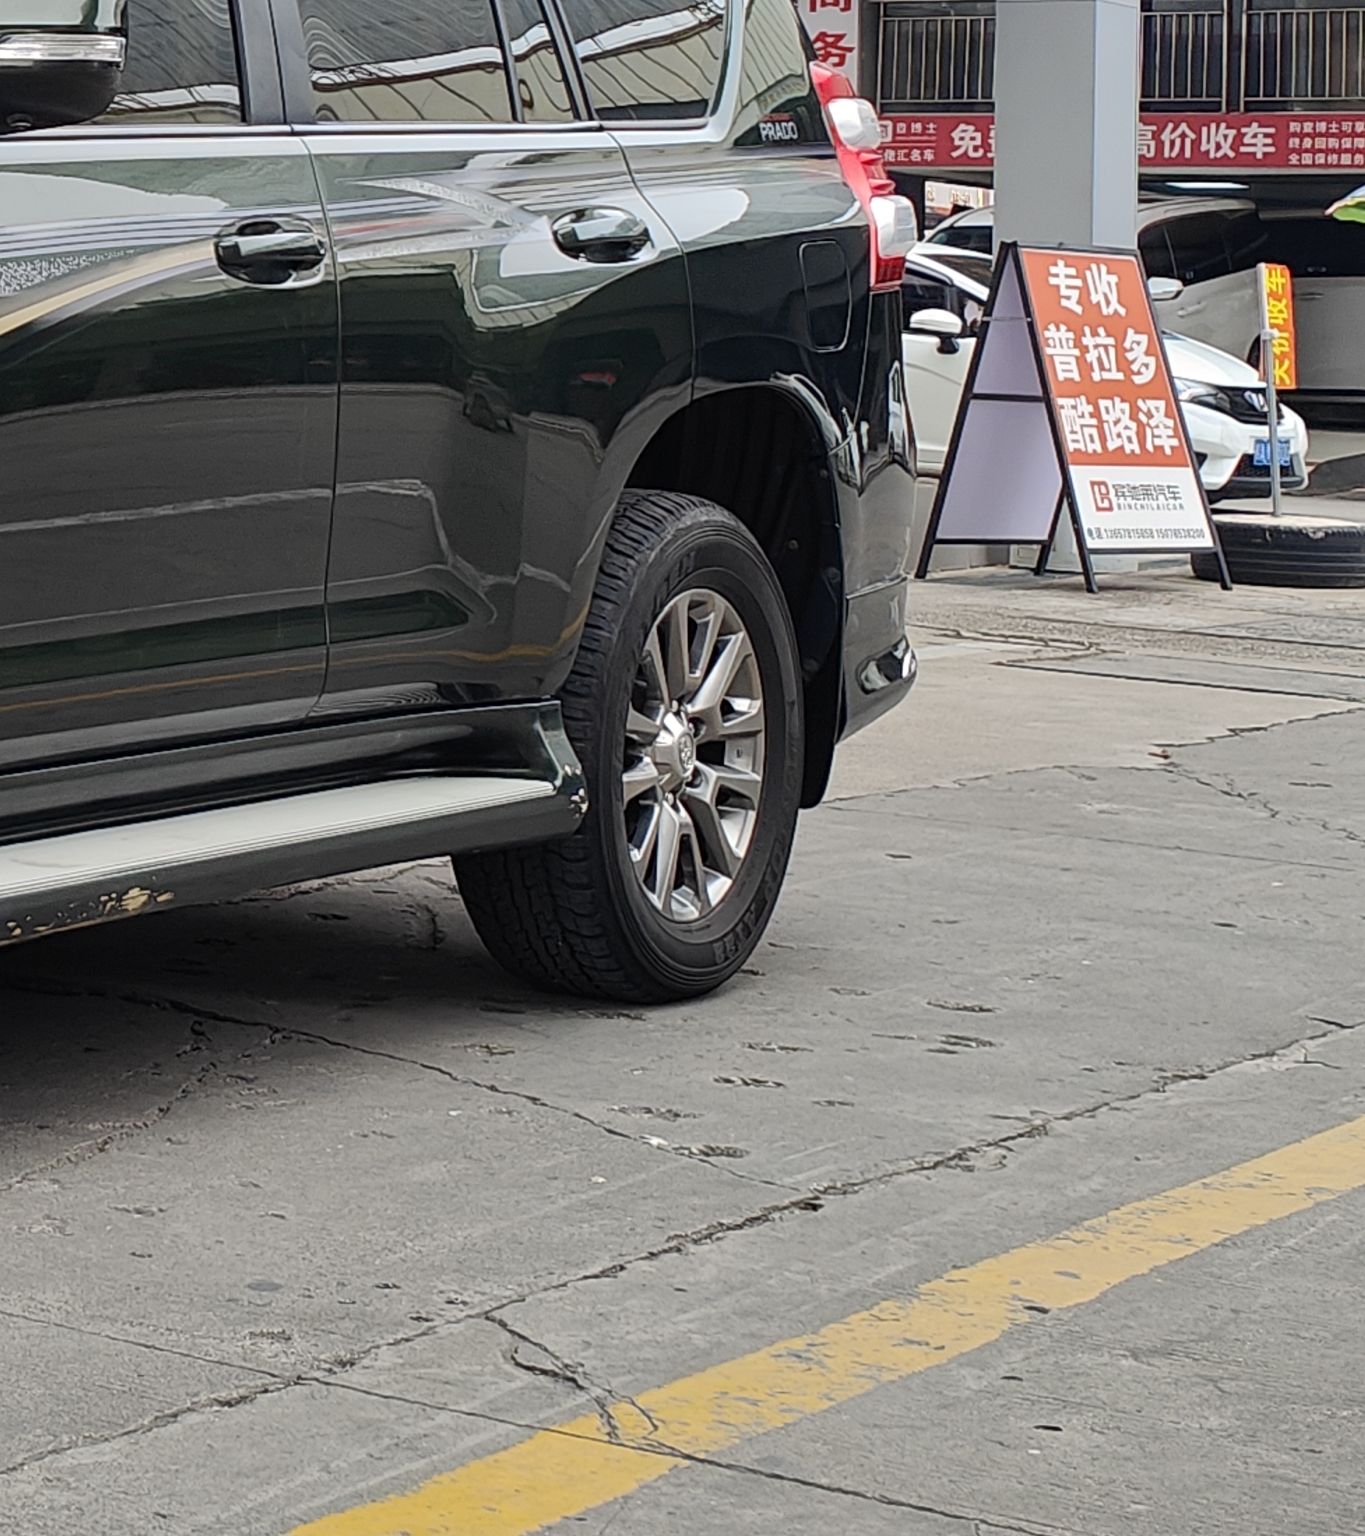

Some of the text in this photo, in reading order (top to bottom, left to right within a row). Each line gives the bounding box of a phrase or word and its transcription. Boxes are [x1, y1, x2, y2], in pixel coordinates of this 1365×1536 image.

[758, 120, 799, 141] PRADO
[1048, 258, 1127, 318] 专收
[1043, 322, 1157, 385] 普拉多
[1056, 394, 1180, 456] 酷路泽
